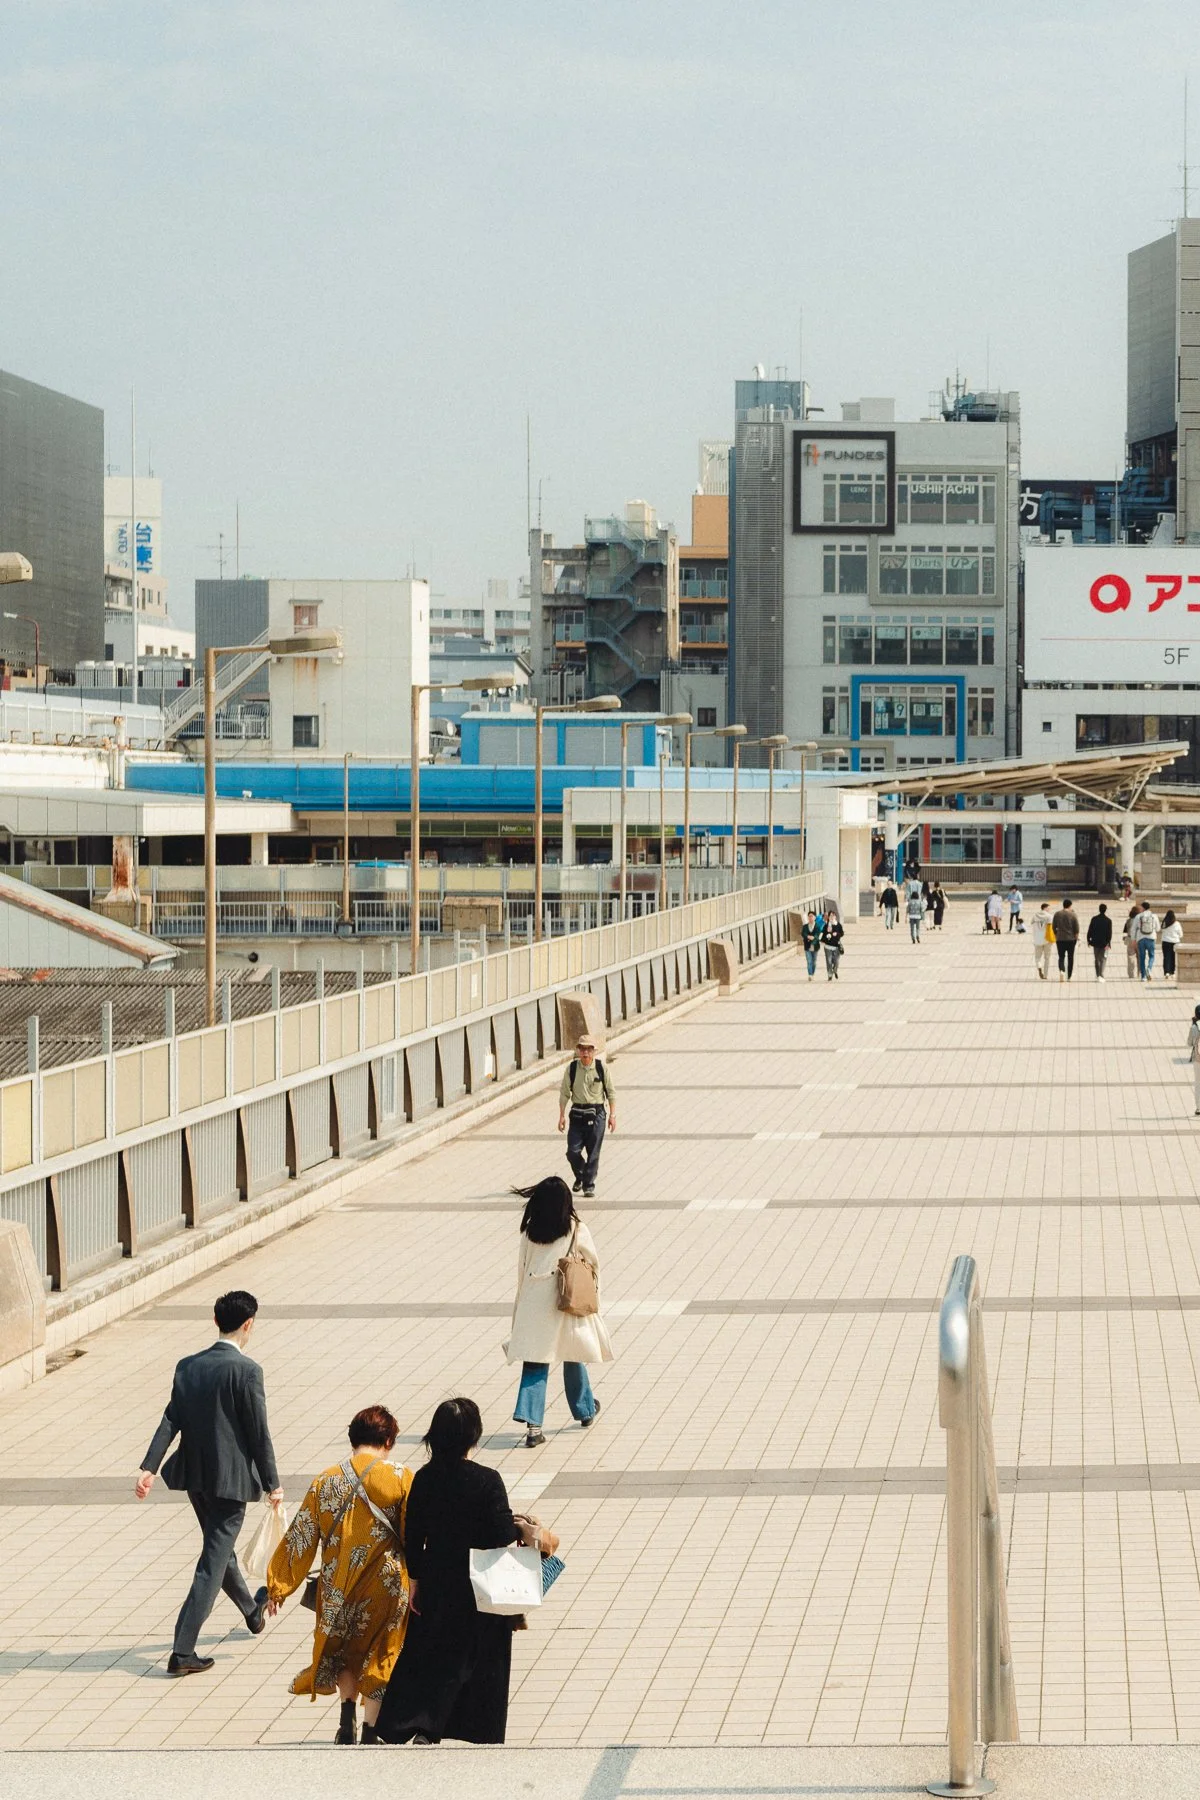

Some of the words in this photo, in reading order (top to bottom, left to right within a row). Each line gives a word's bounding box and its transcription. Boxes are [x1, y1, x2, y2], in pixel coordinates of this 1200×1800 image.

[824, 450, 885, 461] FUNDES
[910, 484, 975, 495] USHIHACHI
[914, 559, 942, 568] Darts
[1163, 647, 1190, 665] 5F
